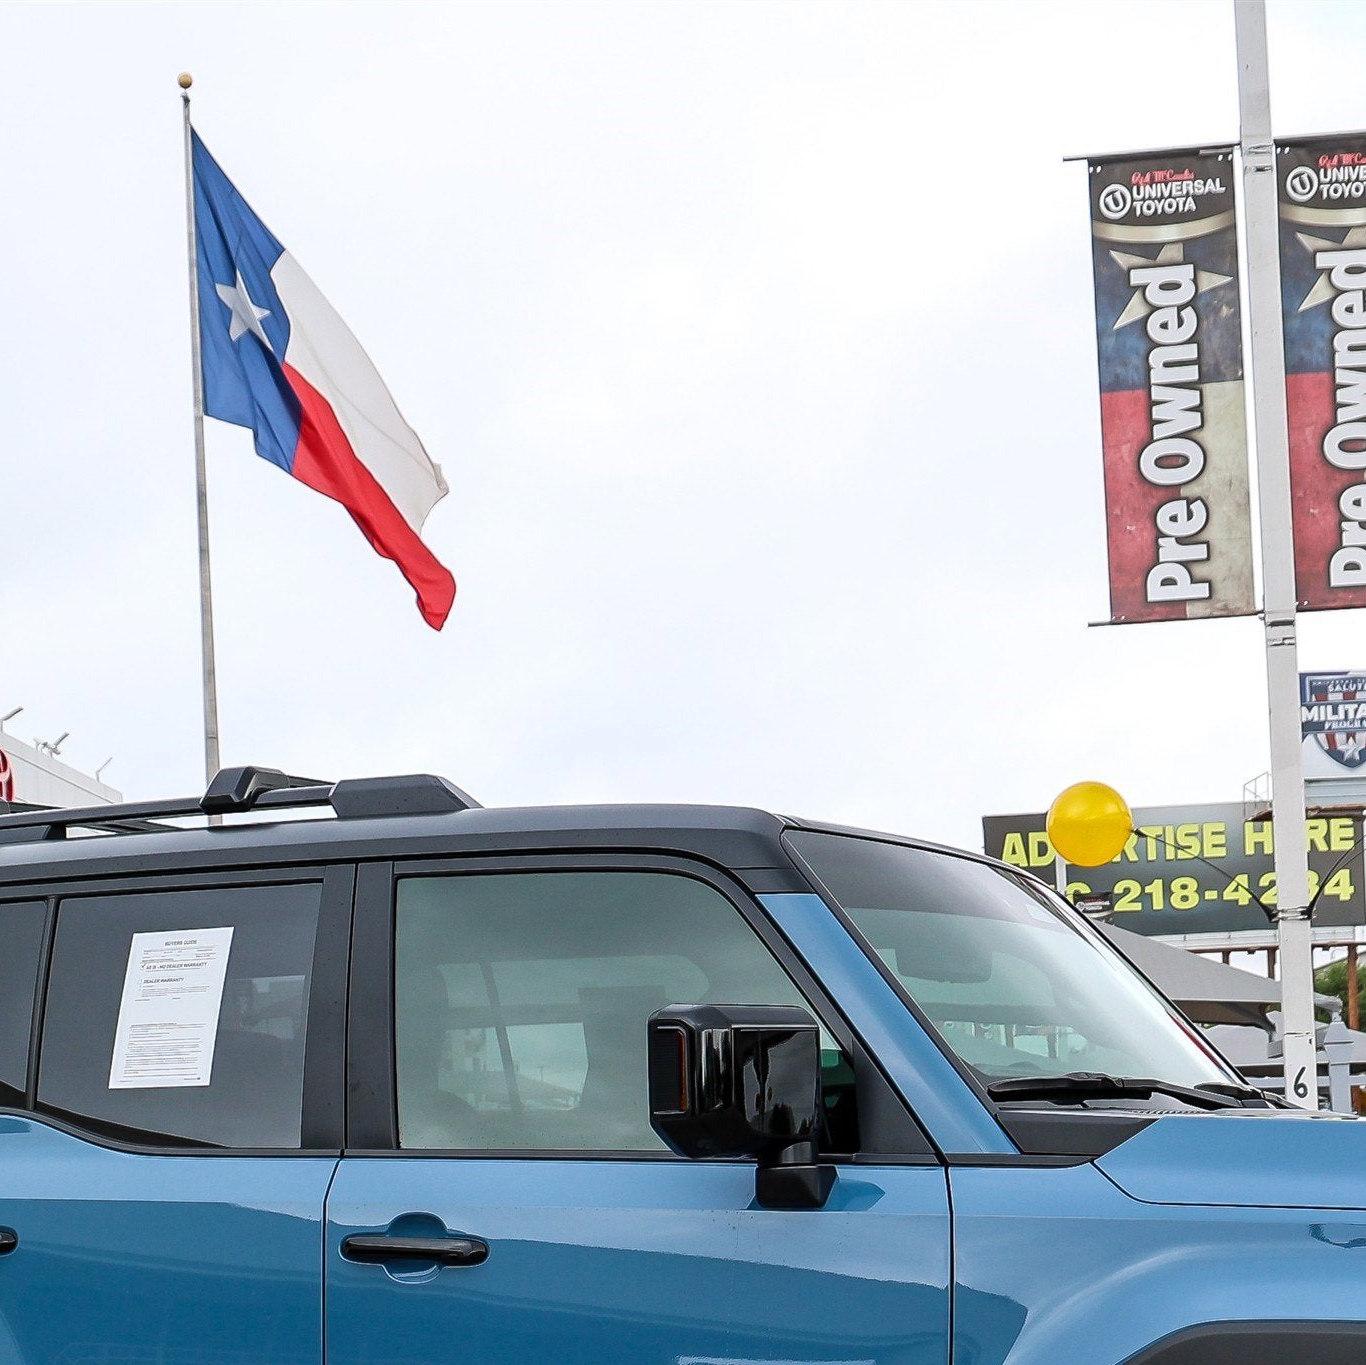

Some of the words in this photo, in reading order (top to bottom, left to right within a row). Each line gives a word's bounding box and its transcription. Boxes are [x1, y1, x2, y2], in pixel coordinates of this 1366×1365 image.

[1132, 177, 1226, 200] UNIVERSAL
[1133, 196, 1196, 217] TOYOTA
[1129, 263, 1207, 486] Owned
[1146, 500, 1211, 602] Pre
[1001, 822, 1227, 867] ADRTISE
[1244, 818, 1355, 856] HRE
[1293, 1066, 1308, 1099] 6
